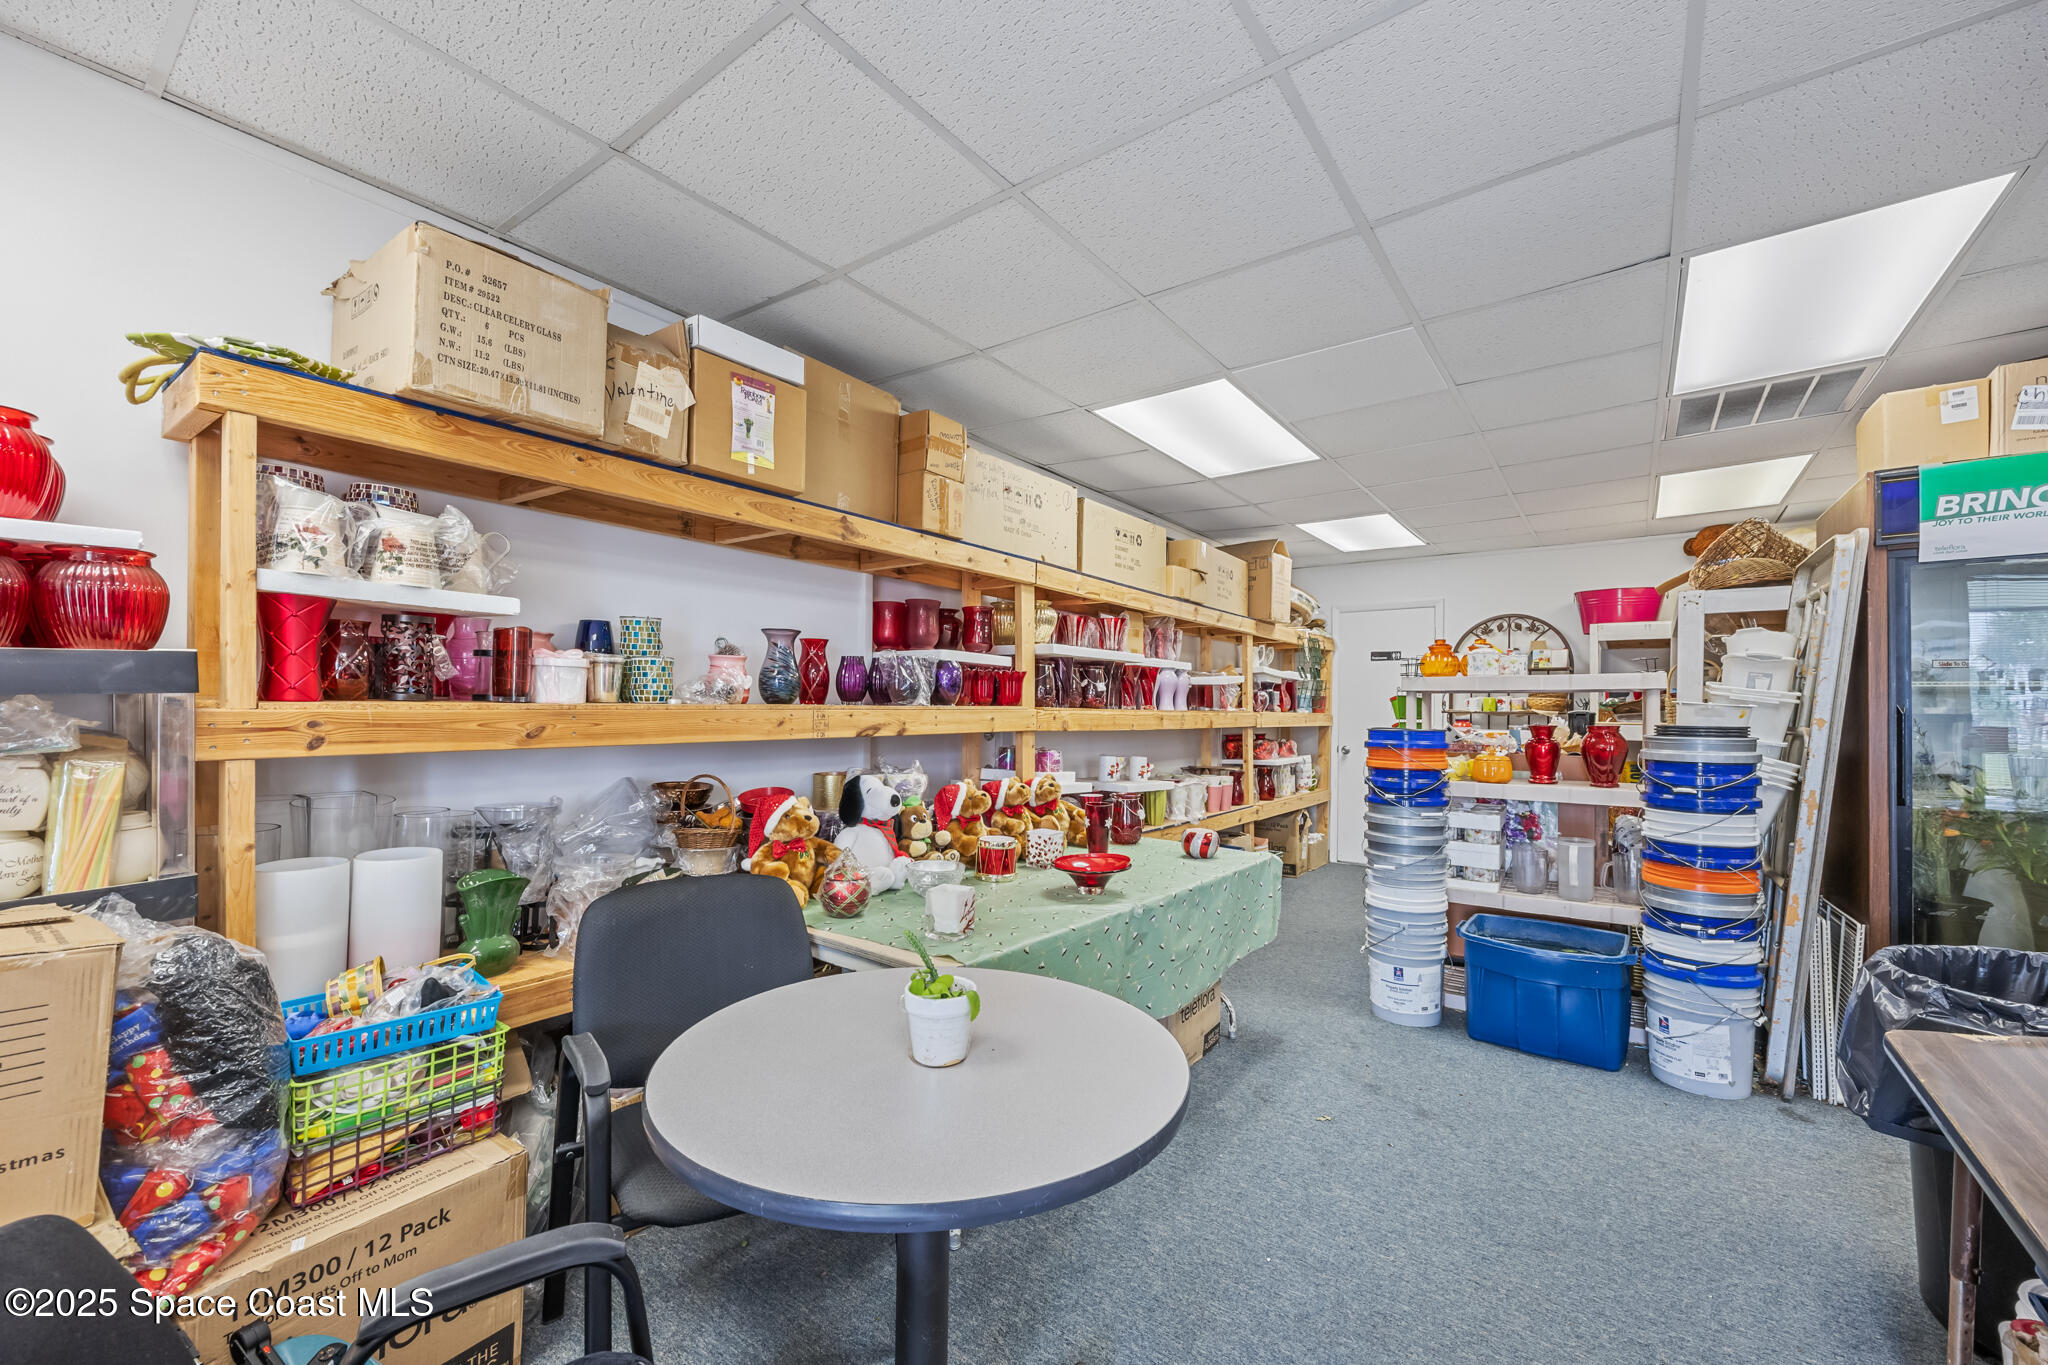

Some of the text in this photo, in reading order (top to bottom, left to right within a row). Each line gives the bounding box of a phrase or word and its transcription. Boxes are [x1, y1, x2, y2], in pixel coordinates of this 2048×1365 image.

[482, 274, 508, 291] 32657
[477, 288, 501, 303] 29522
[473, 302, 502, 321] CLEAR
[503, 313, 536, 332] CELERY
[536, 325, 562, 342] GLASS
[485, 321, 490, 330] 6
[508, 329, 525, 342] PCS
[504, 343, 526, 358] (LBS)
[474, 349, 490, 361] 11.2
[503, 358, 525, 372] (LBS)
[1932, 519, 1954, 527] JOY
[1977, 513, 2010, 523] THEIR
[395, 1169, 423, 1185] Mom
[364, 1232, 392, 1258] 12
[400, 1207, 452, 1243] Pack
[340, 1268, 364, 1288] Off
[365, 1263, 381, 1277] to
[383, 1246, 418, 1269] Mom
